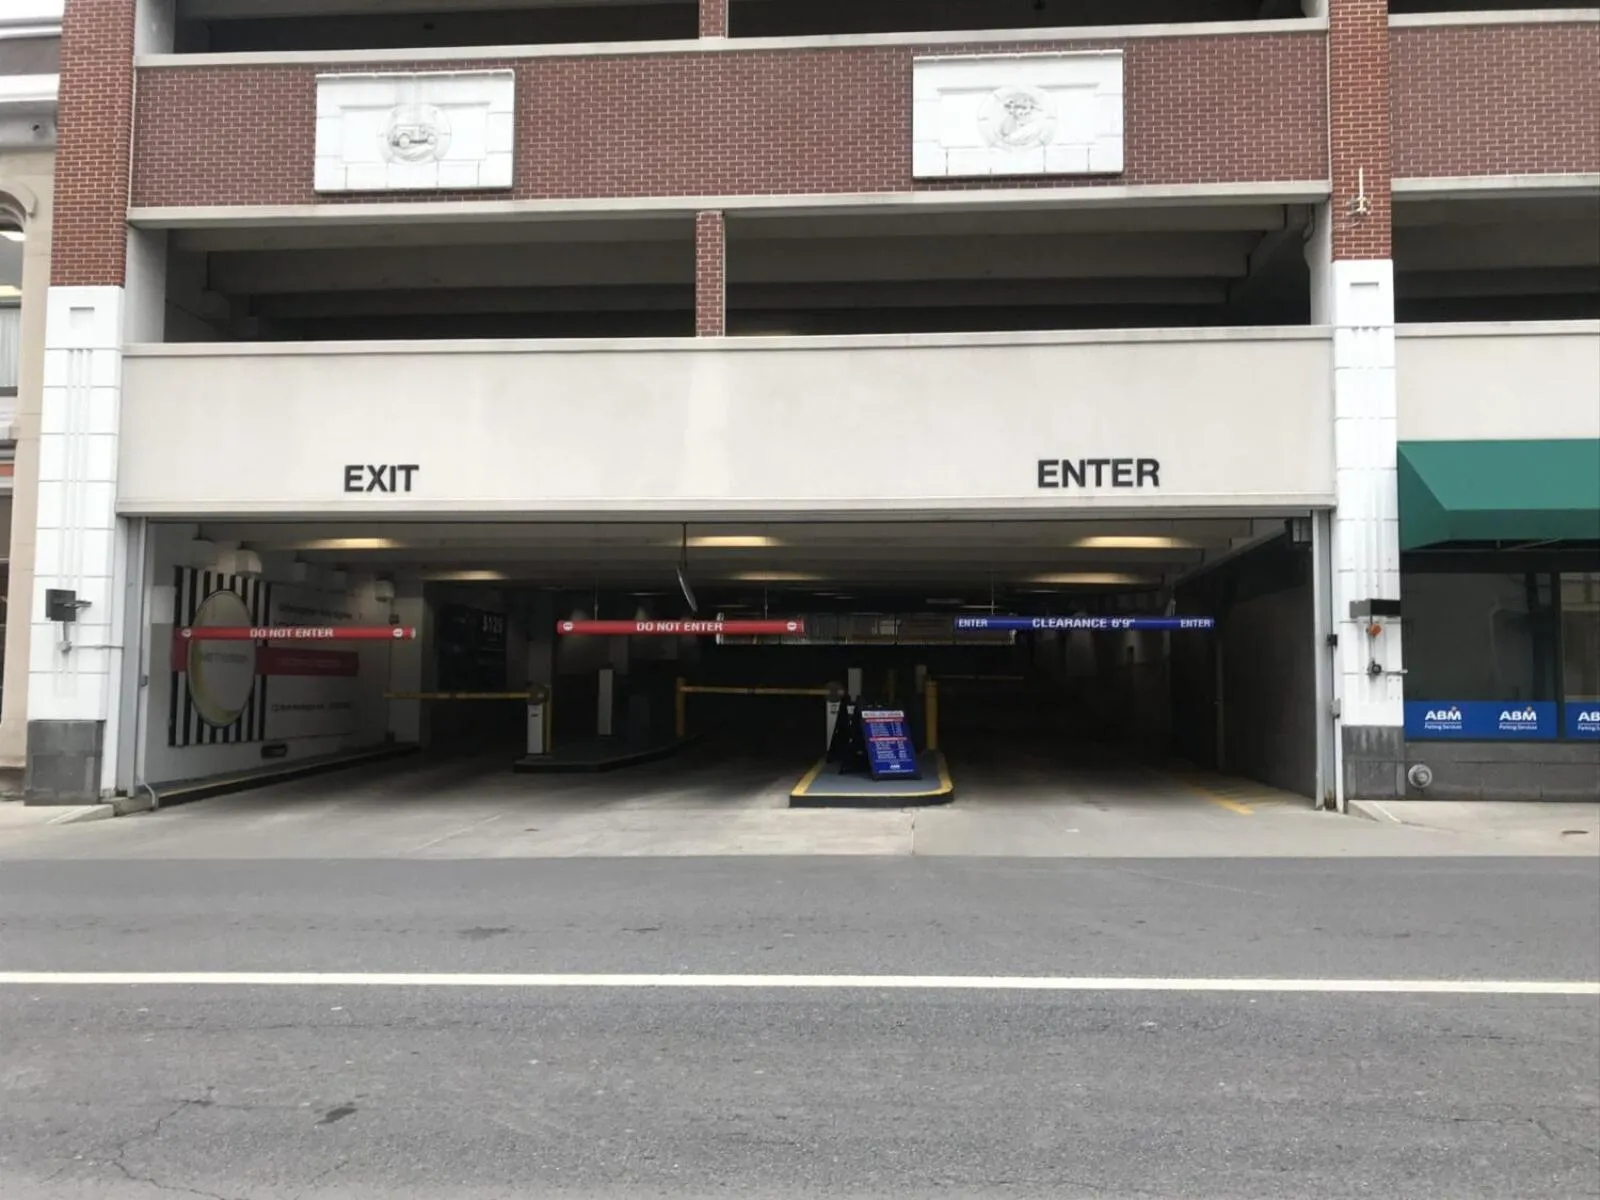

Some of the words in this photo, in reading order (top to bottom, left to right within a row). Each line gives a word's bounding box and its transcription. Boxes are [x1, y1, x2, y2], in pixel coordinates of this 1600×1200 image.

[344, 464, 419, 492] EXIT
[1038, 458, 1160, 488] ENTER
[635, 621, 654, 632] DO
[656, 621, 681, 632] NOT
[683, 621, 724, 632] ENTER
[958, 618, 988, 628] ENTER
[1031, 617, 1107, 629] CLEARANCE
[1180, 618, 1211, 629] ENTER
[249, 627, 267, 638] DO
[269, 627, 293, 638] NOT
[295, 627, 334, 638] ENTER
[1424, 710, 1462, 721] ABM
[1499, 710, 1537, 721] ABM
[1578, 711, 1600, 721] AB
